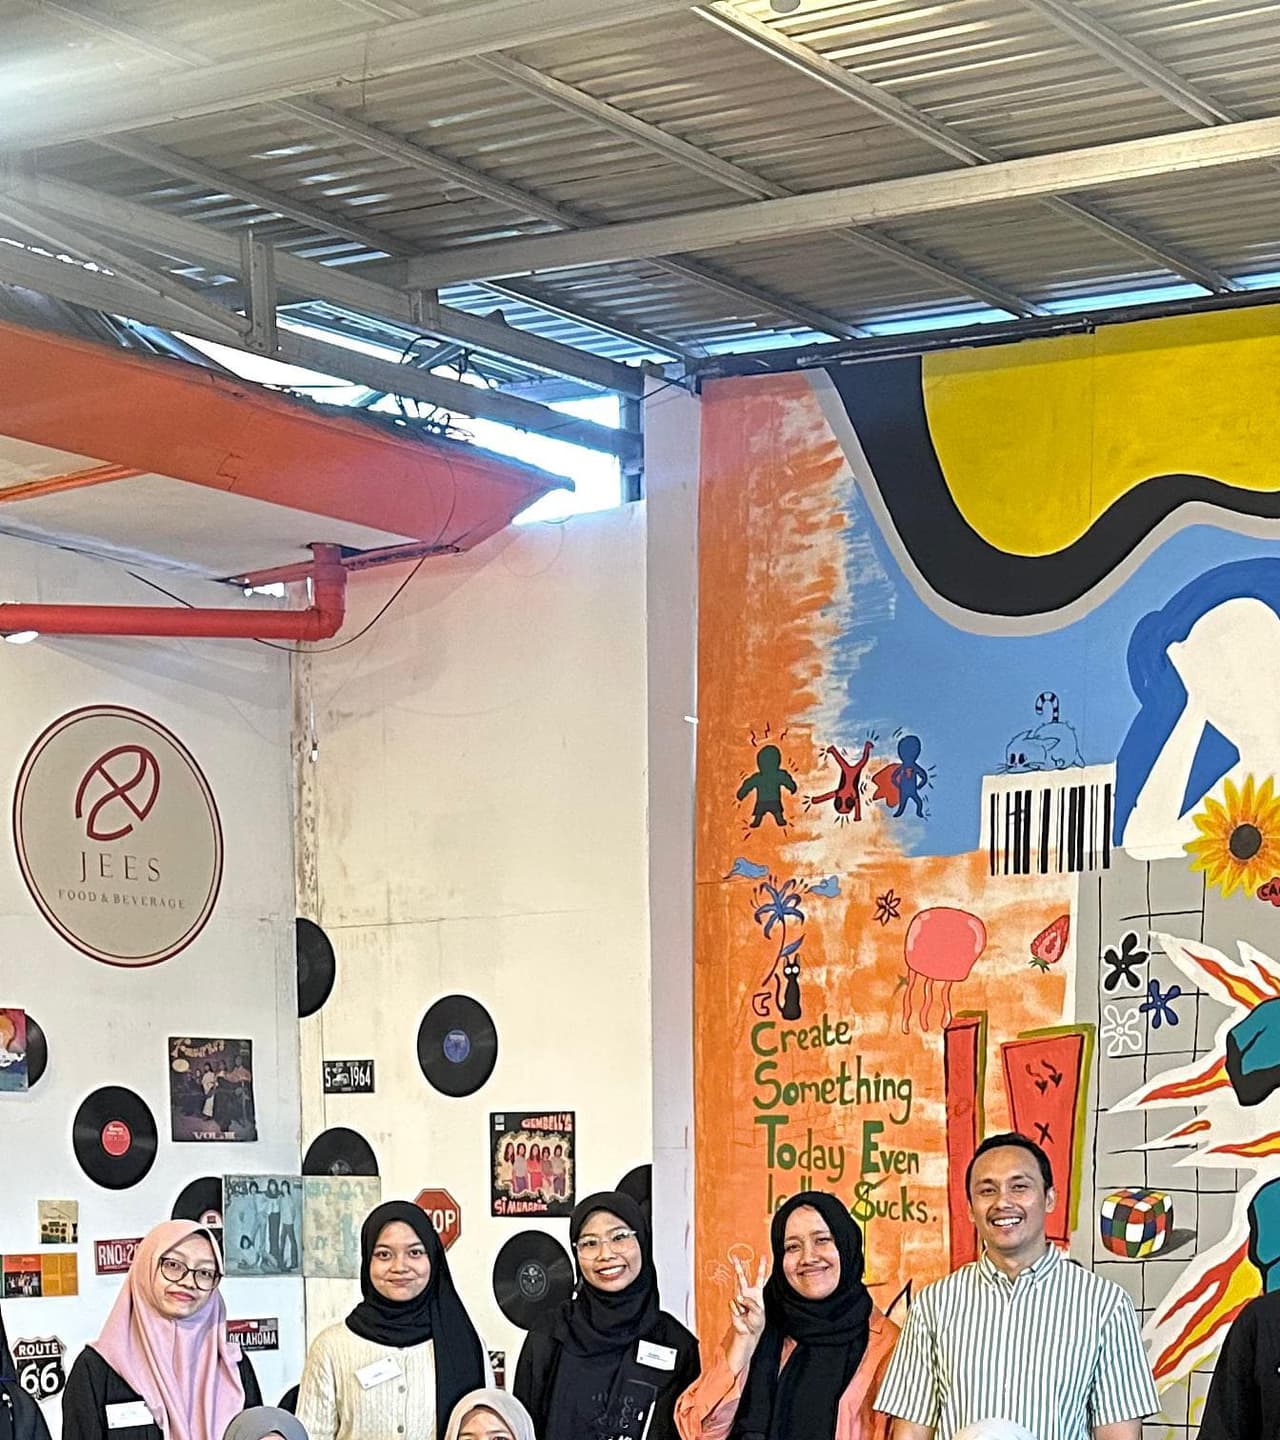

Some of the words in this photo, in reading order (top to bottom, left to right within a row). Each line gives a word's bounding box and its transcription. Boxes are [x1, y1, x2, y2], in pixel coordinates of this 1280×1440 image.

[80, 851, 160, 882] JEES
[59, 889, 97, 902] FOOD
[113, 893, 185, 909] BEVERAGE
[751, 1014, 853, 1056] Create
[350, 1066, 371, 1087] 1964
[753, 1056, 912, 1124] Something
[755, 1116, 847, 1183] Today
[861, 1121, 920, 1176] Even
[423, 1208, 456, 1233] OP
[18, 1343, 59, 1356] ROUTE
[228, 1331, 277, 1345] OKLAHOMA
[20, 1361, 59, 1394] 66
